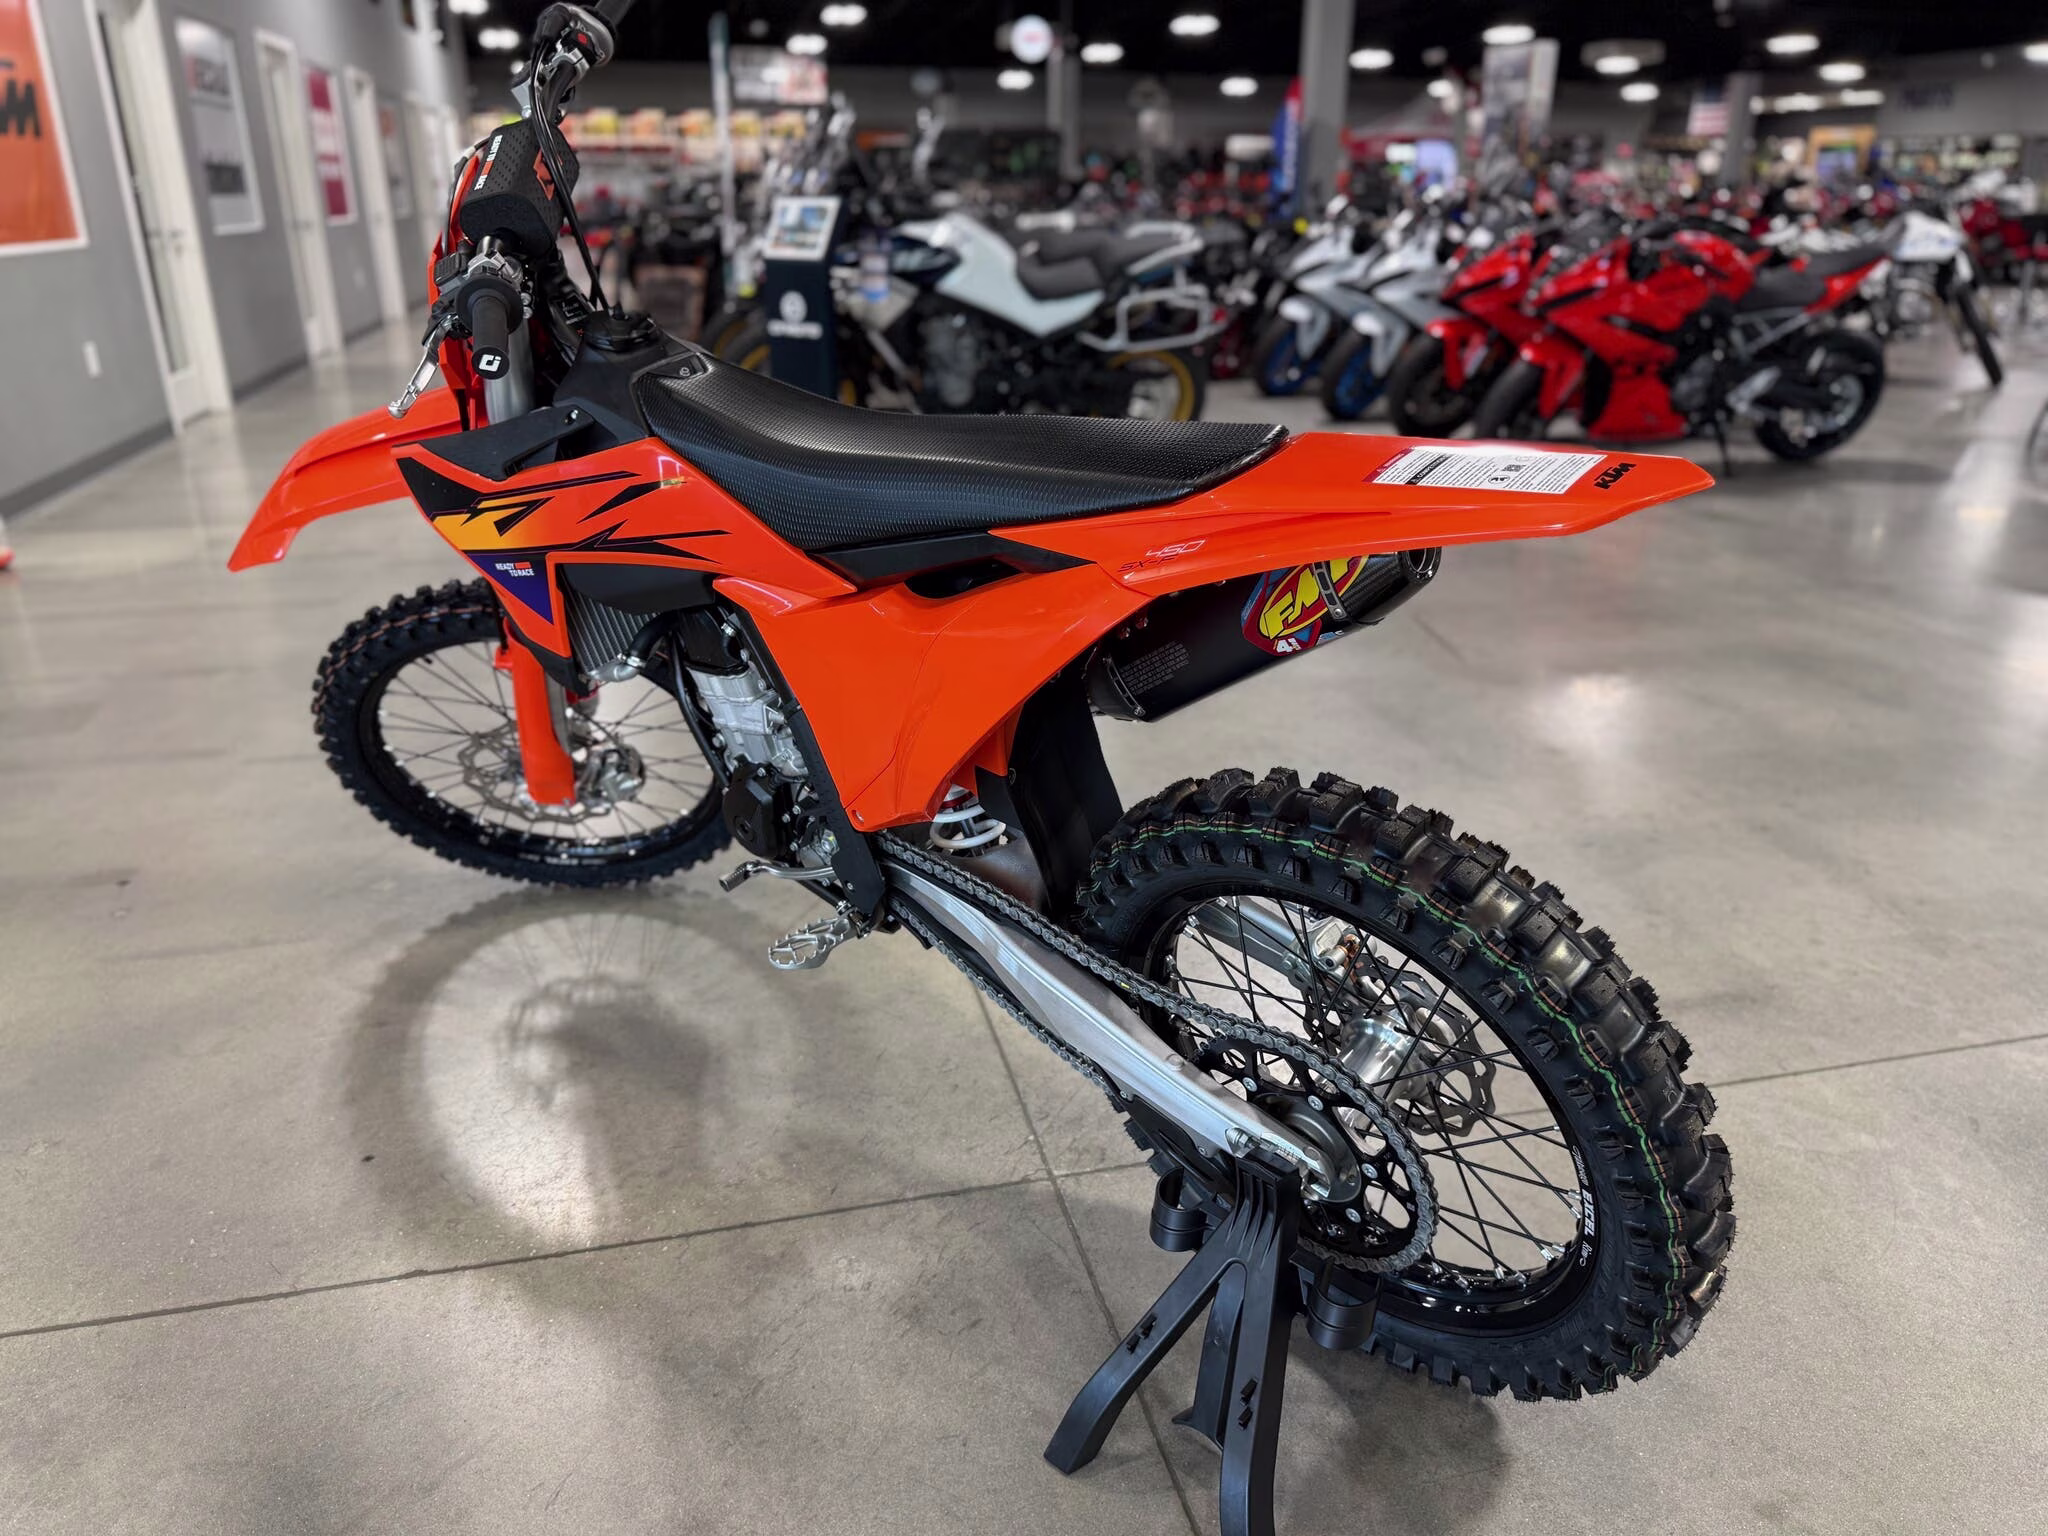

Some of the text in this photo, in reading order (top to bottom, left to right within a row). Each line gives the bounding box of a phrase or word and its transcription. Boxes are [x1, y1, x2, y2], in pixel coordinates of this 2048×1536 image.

[474, 174, 488, 191] RACE
[1594, 462, 1637, 489] KTM
[1145, 540, 1206, 557] 450
[495, 562, 515, 570] READY
[1118, 554, 1178, 572] SX-F
[518, 568, 535, 576] RACE
[1582, 1188, 1595, 1237] EXCEL
